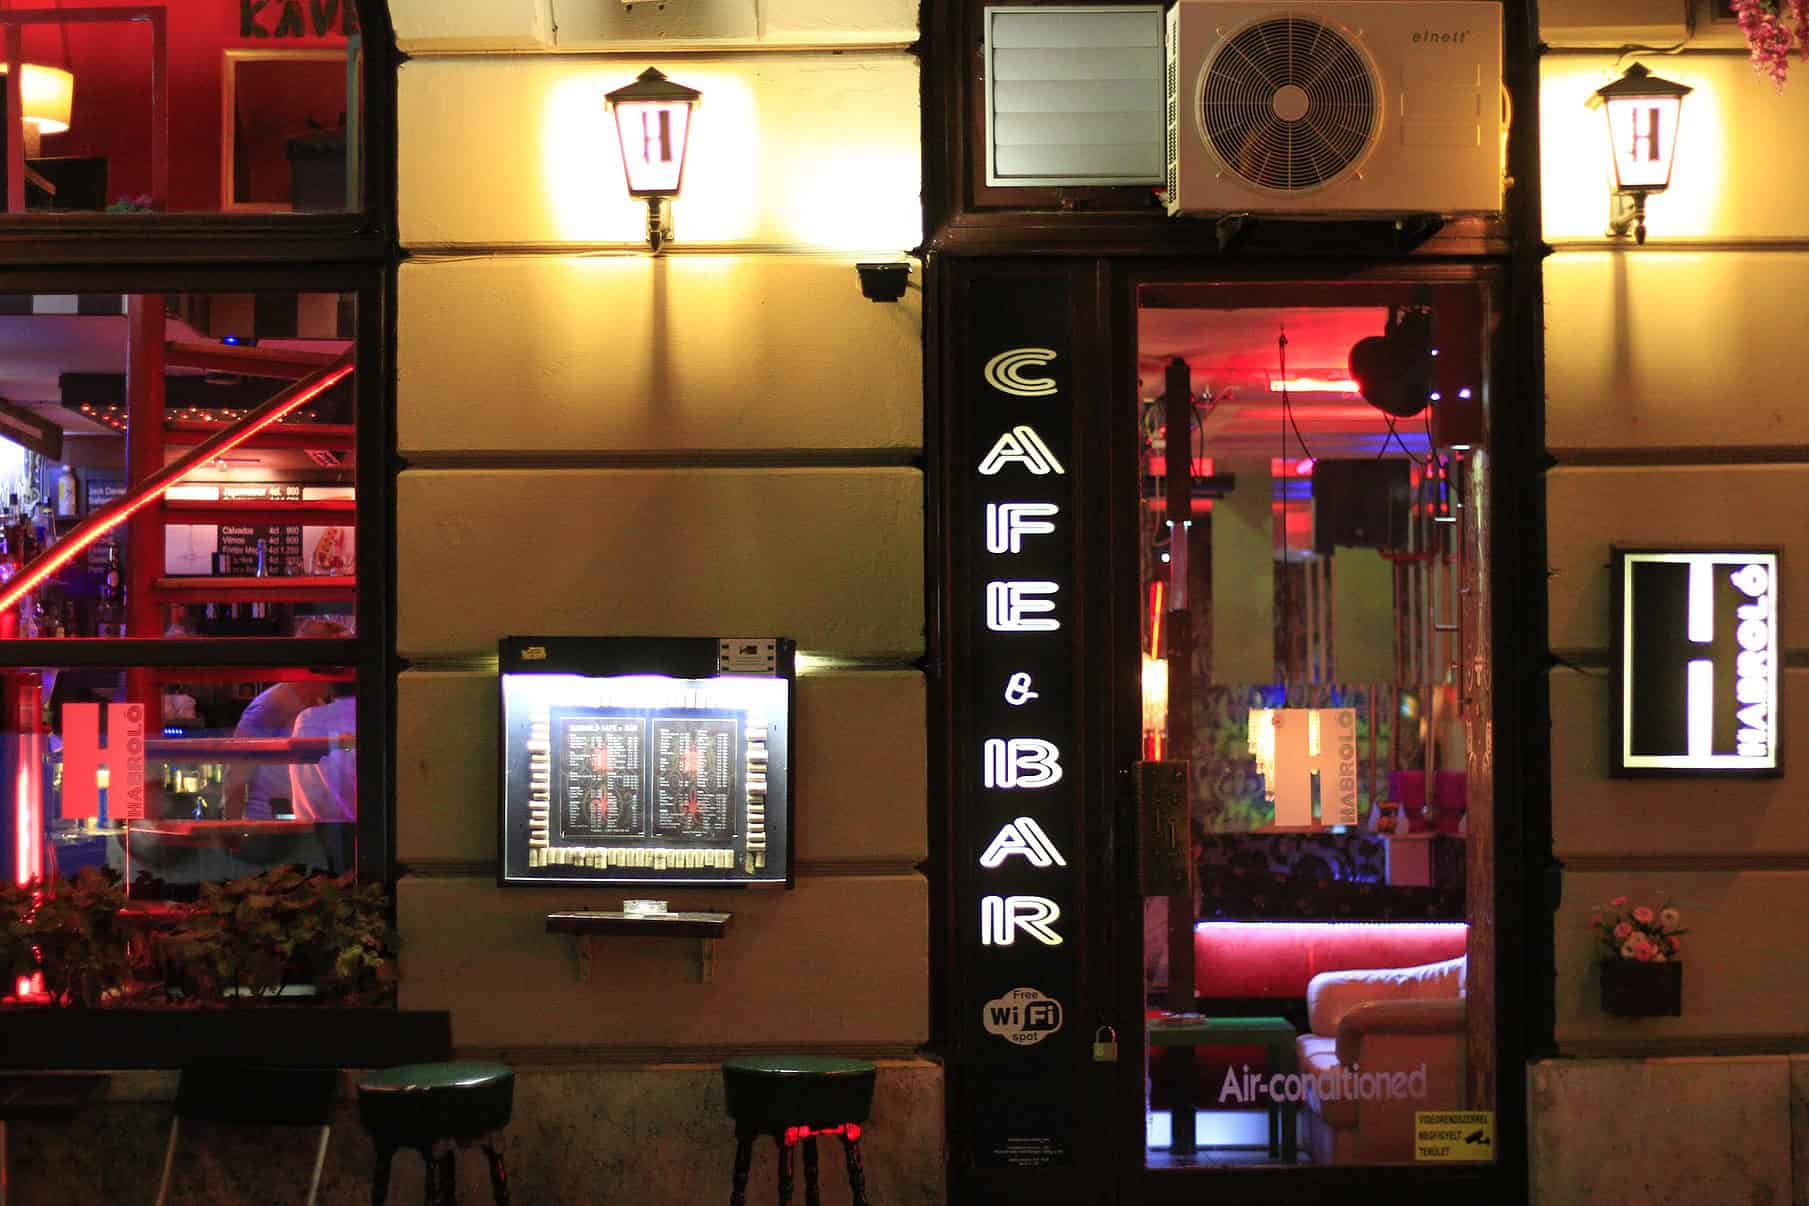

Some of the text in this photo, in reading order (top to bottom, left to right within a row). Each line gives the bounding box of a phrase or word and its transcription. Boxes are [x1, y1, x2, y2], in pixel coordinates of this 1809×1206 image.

[977, 347, 1067, 946] CAFE & BAR
[1012, 991, 1039, 1000] Free
[1012, 1032, 1038, 1041] spot
[1218, 1063, 1427, 1104] Air-conditioned
